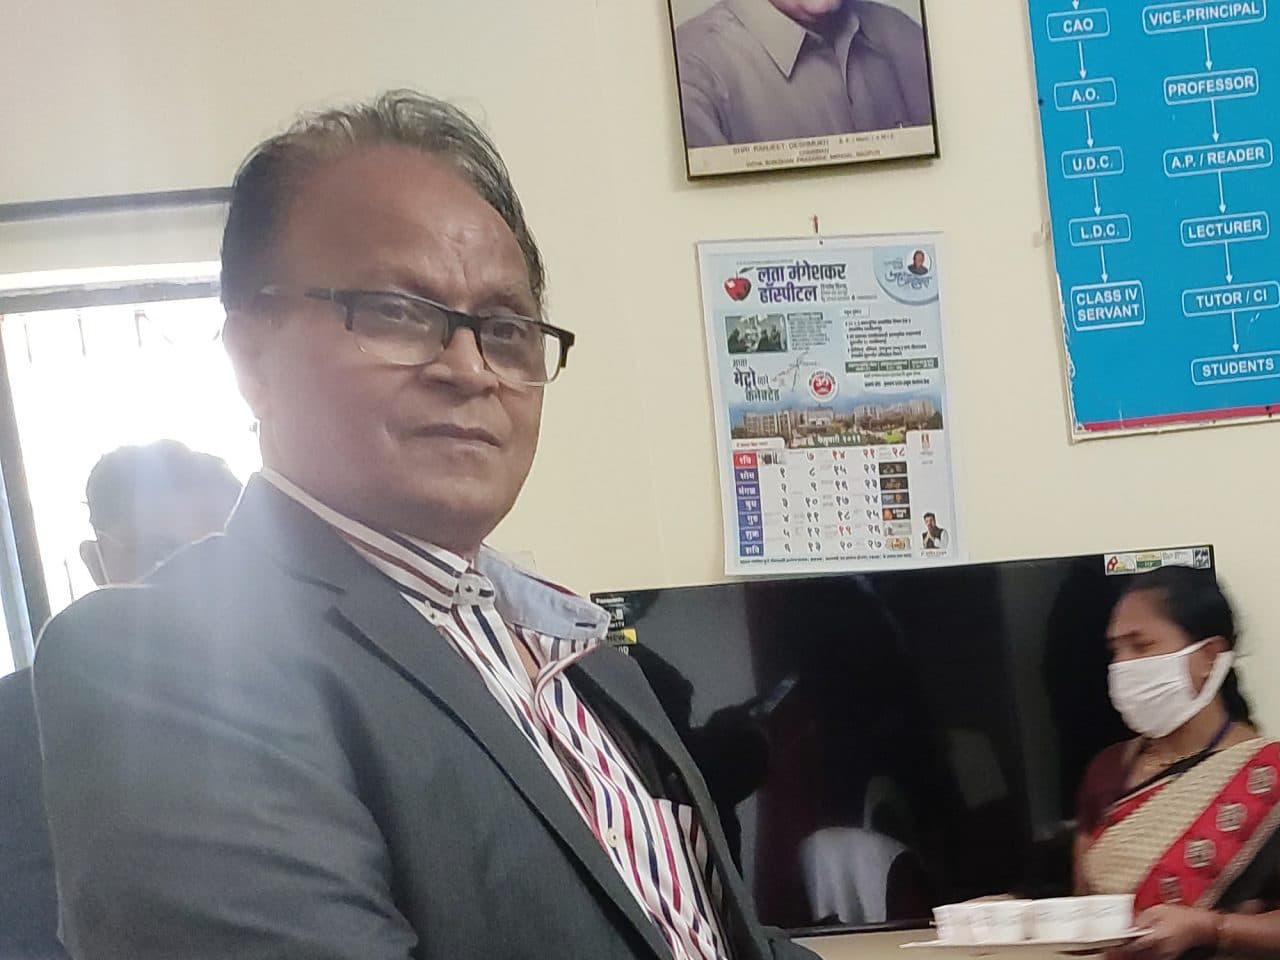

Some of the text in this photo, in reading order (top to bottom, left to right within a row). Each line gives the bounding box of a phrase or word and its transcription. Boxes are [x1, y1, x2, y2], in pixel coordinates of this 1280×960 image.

[1149, 3, 1261, 25] VICE-PRINCIPAL
[1063, 17, 1095, 33] CAO
[1071, 88, 1101, 103] A.O.
[1168, 76, 1255, 97] PROFESSOR
[1072, 156, 1114, 172] U.D.C.
[1171, 147, 1265, 169] A.P. / READER
[1080, 224, 1120, 239] L.D.C.
[1188, 219, 1262, 239] LECTURER
[756, 256, 848, 283] लता मंगेशकर
[757, 280, 818, 304] हॉस्पीटल
[1076, 289, 1137, 306] CLASS IV
[1195, 290, 1268, 308] TUTOR / CI
[1077, 304, 1140, 321] SERVANT
[1201, 359, 1275, 378] STUDENTS
